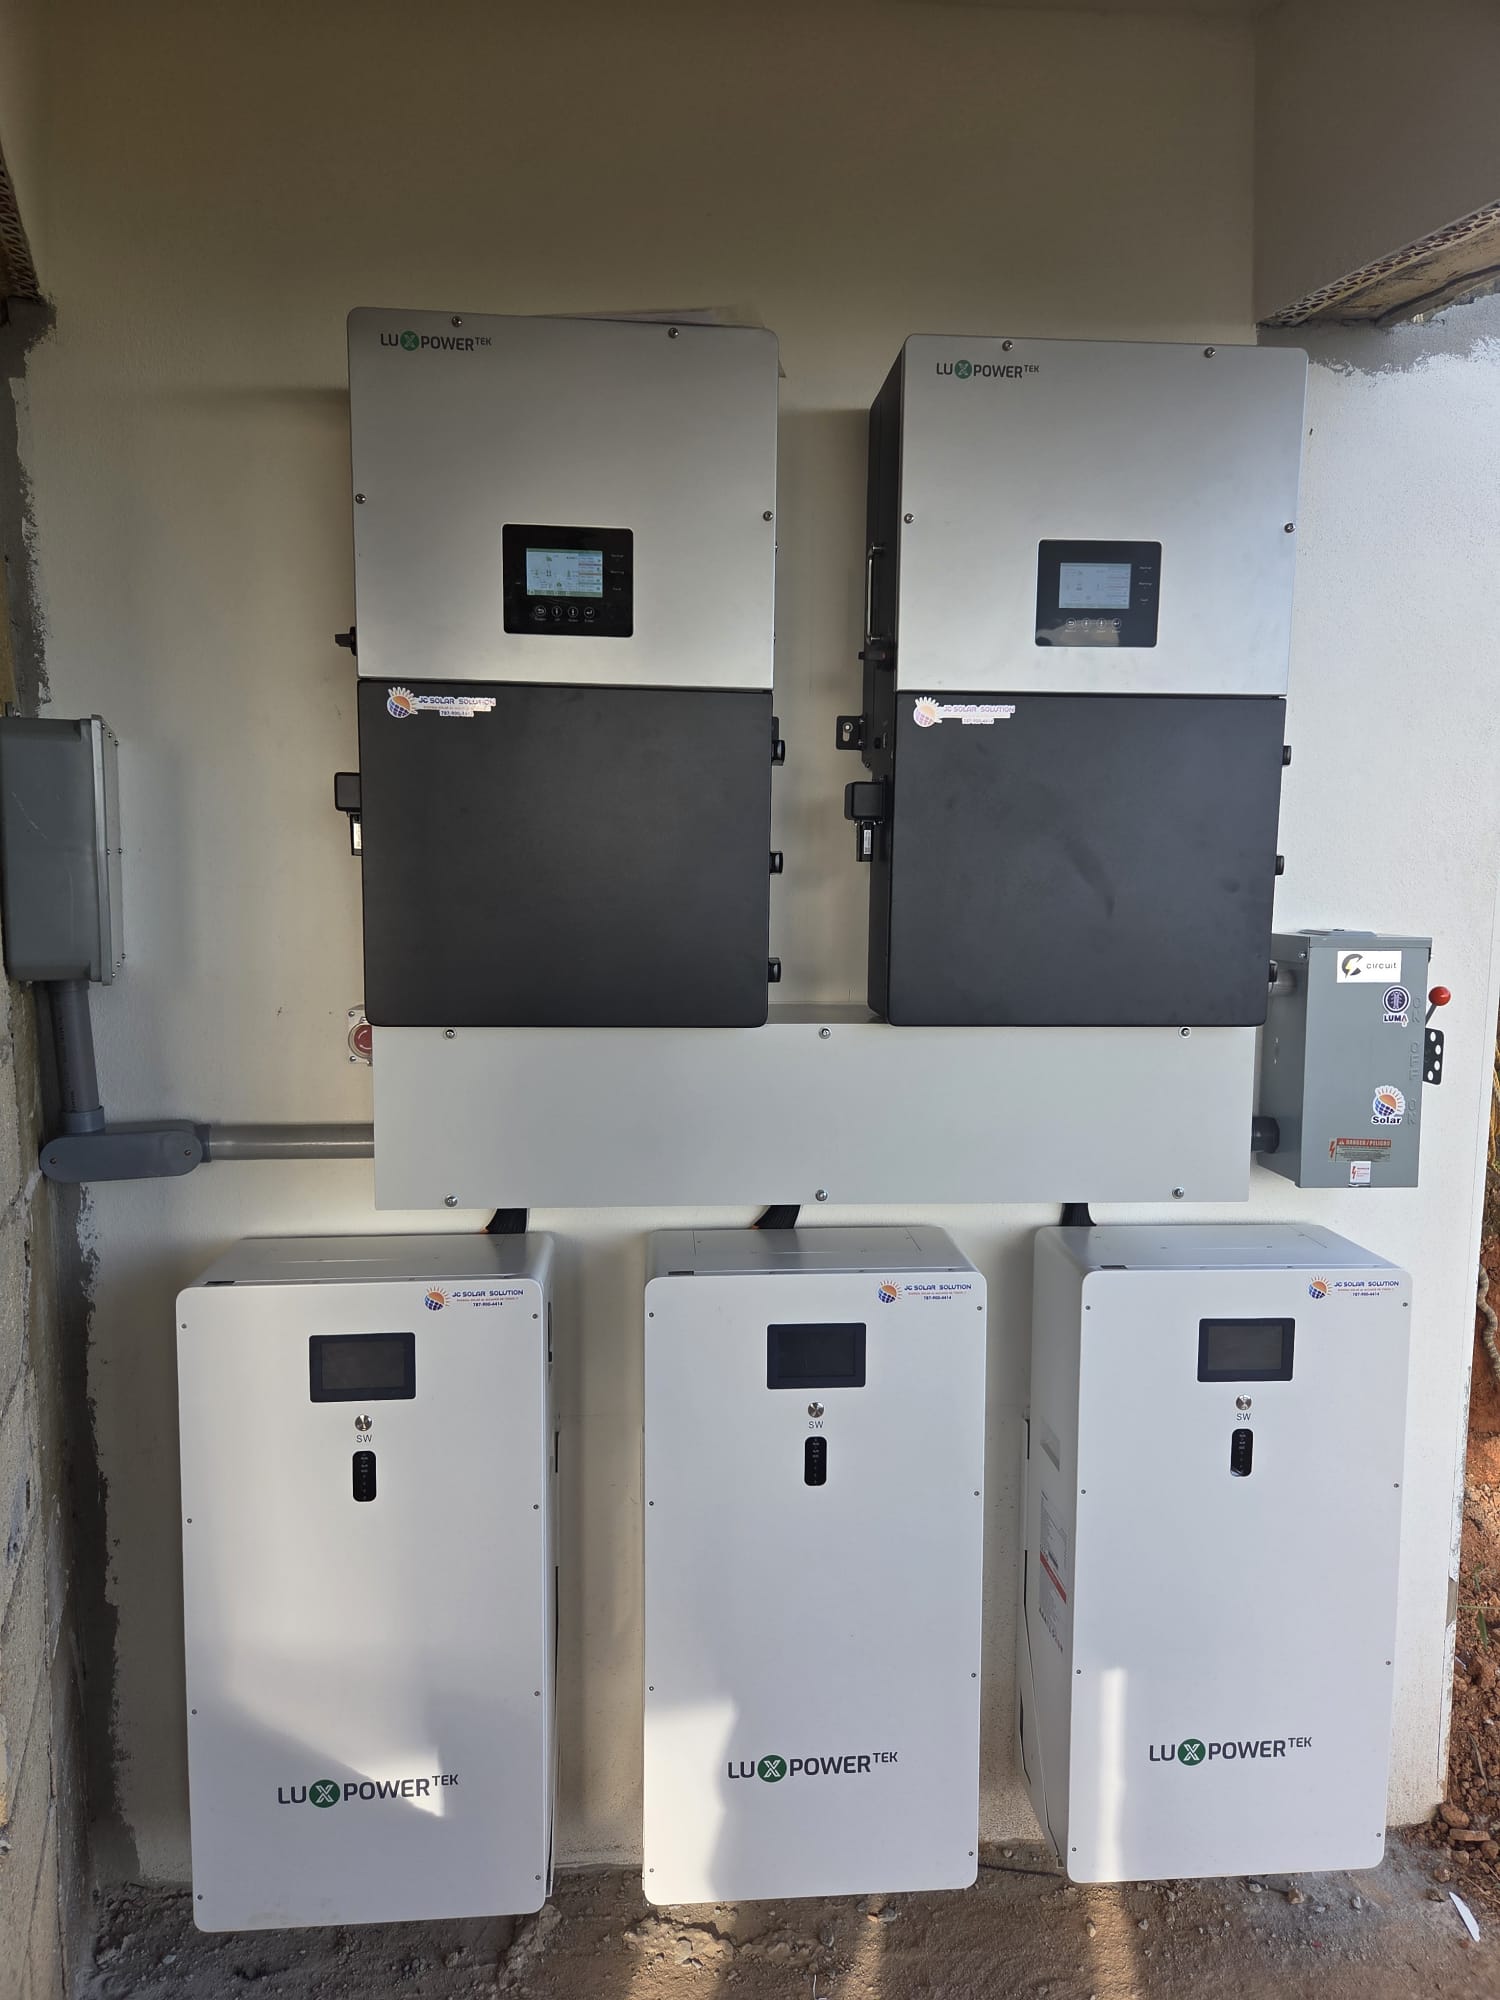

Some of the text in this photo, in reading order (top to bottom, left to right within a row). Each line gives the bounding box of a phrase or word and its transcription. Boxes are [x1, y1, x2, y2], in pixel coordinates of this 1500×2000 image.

[1384, 1014, 1407, 1024] LUMA
[1372, 1116, 1401, 1124] Solar
[1236, 1412, 1251, 1421] SW
[808, 1420, 823, 1429] SW
[356, 1434, 372, 1443] SW
